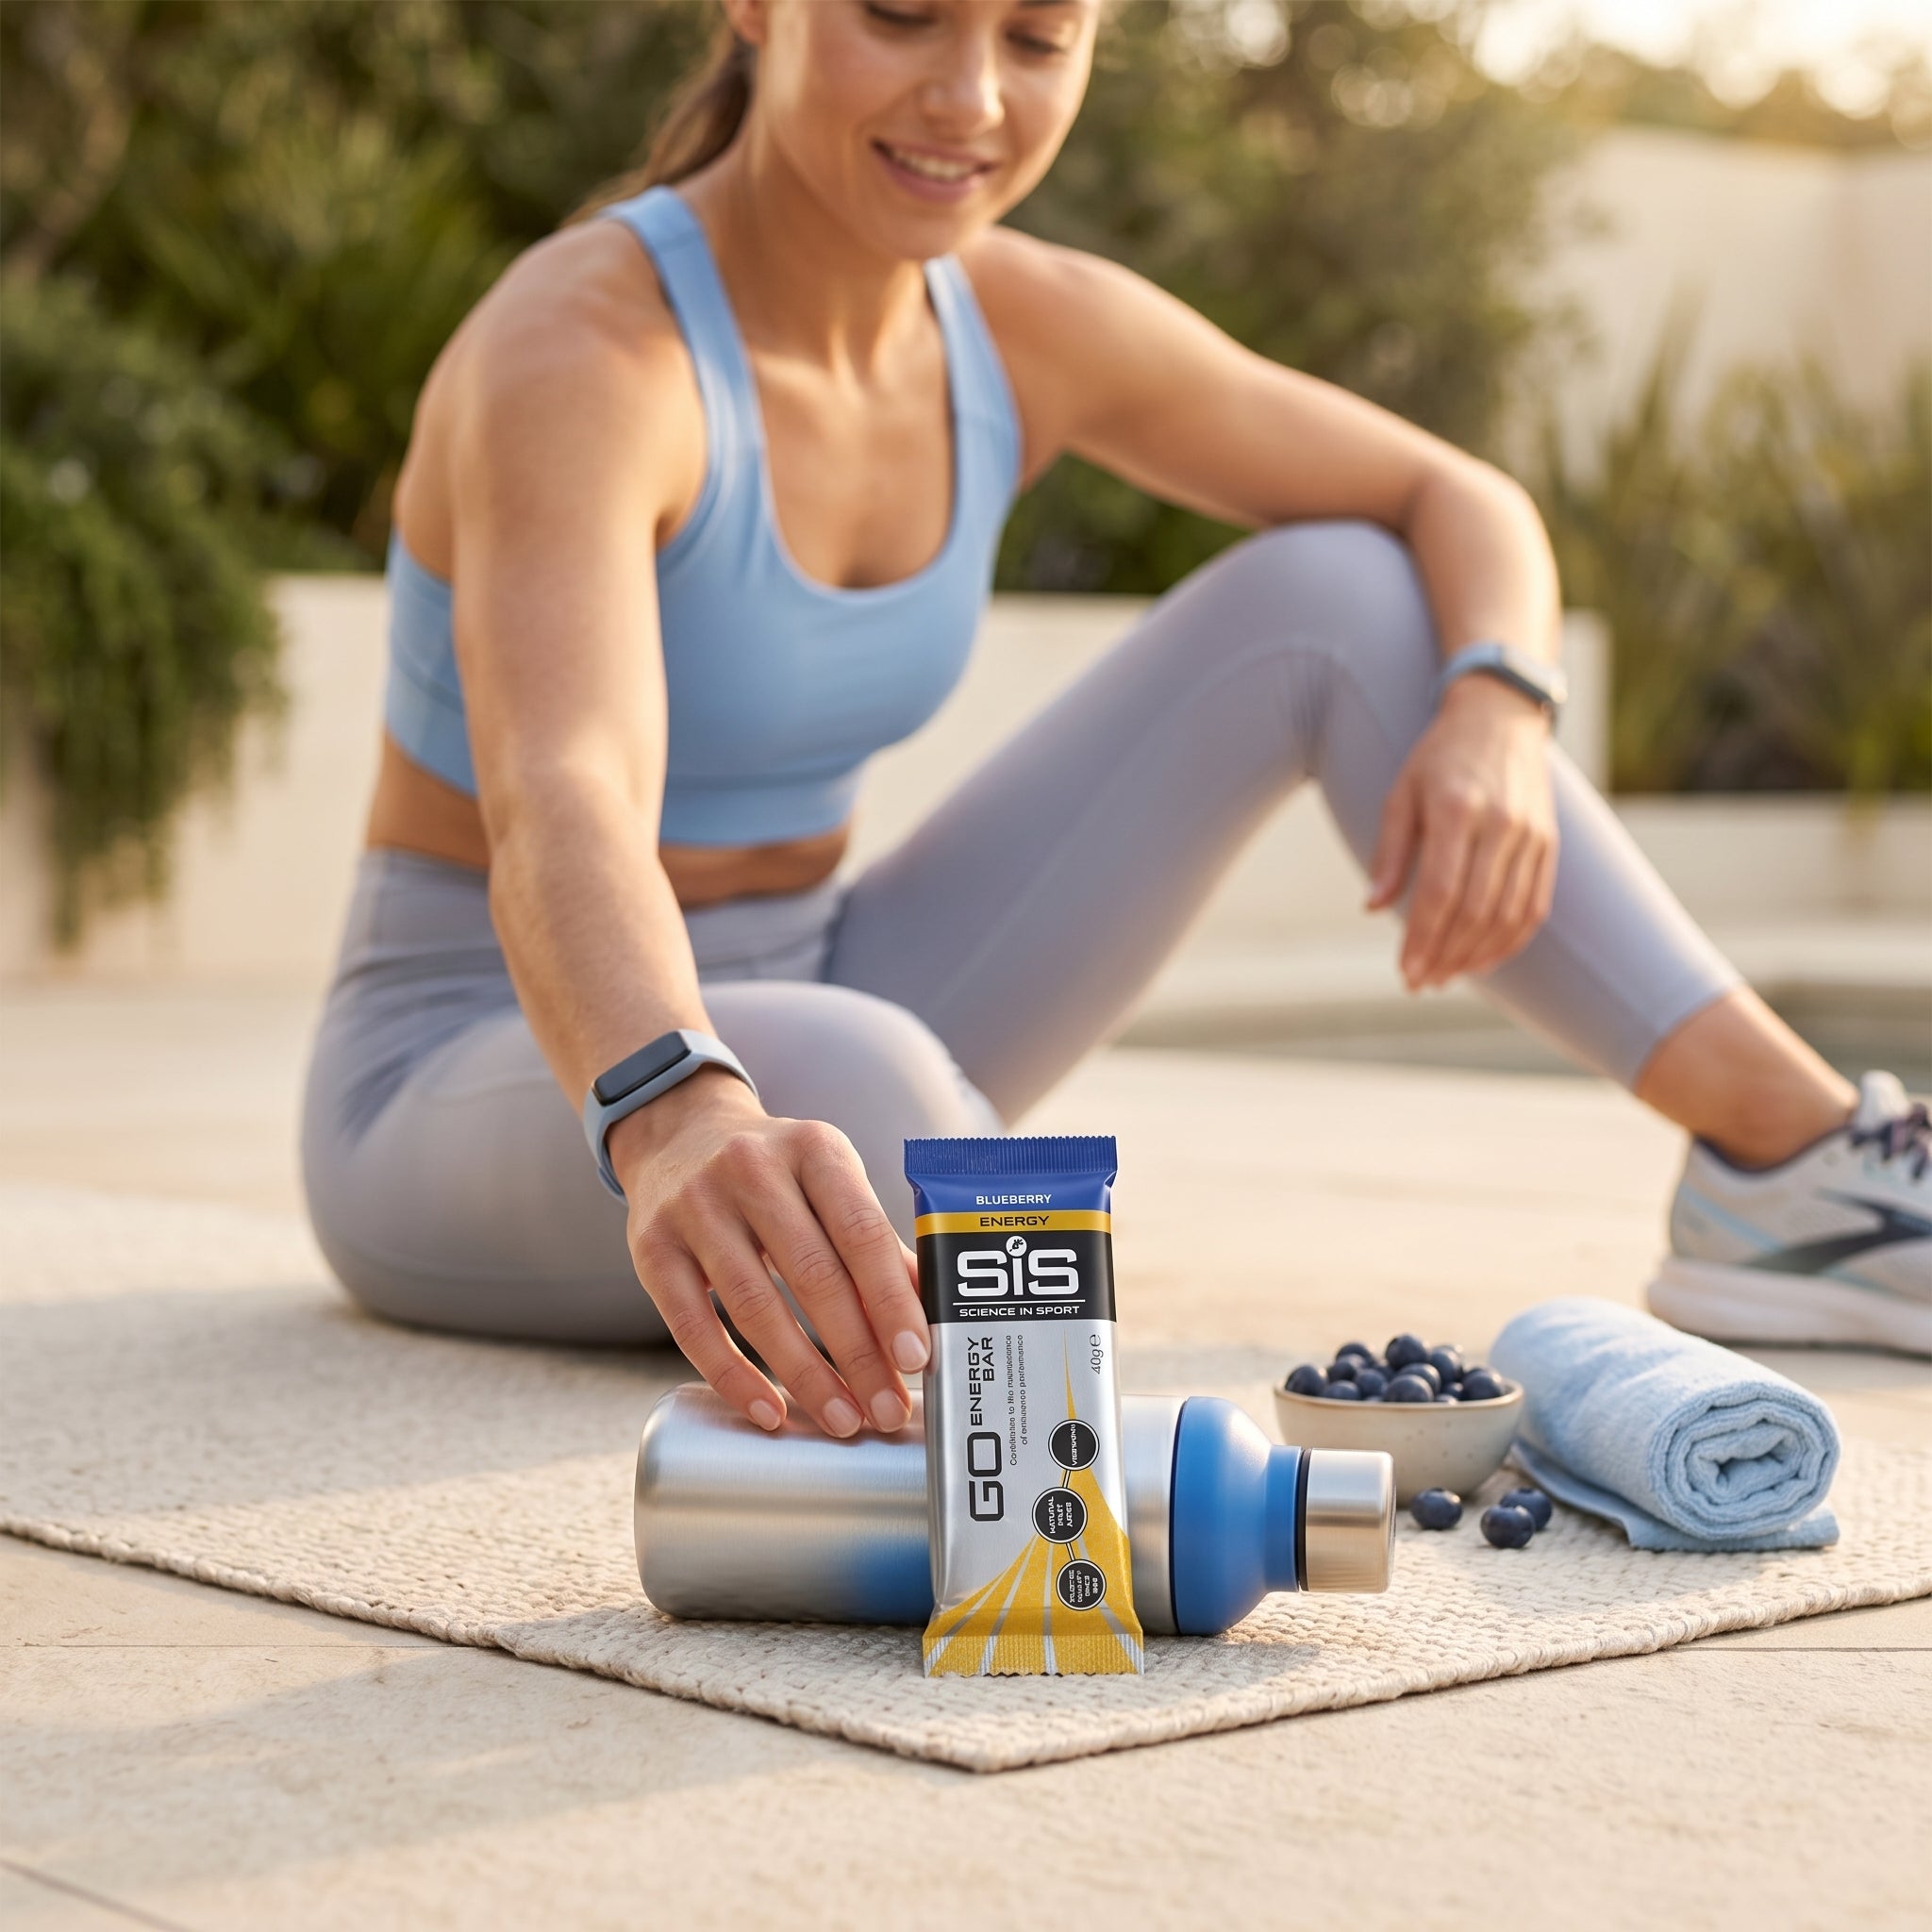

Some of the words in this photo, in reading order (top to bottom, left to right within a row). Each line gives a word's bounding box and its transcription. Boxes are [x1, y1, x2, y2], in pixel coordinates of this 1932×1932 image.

[975, 1194, 1052, 1206] BLUEBERRY
[979, 1215, 1049, 1227] ENERGY
[959, 1307, 1016, 1317] SCIENCE
[1020, 1307, 1034, 1316] IN
[1036, 1306, 1080, 1316] SPORT
[981, 1336, 994, 1382] BAR
[1090, 1348, 1104, 1374] 40g
[967, 1336, 983, 1426] ENERGY
[967, 1431, 1005, 1522] GO
